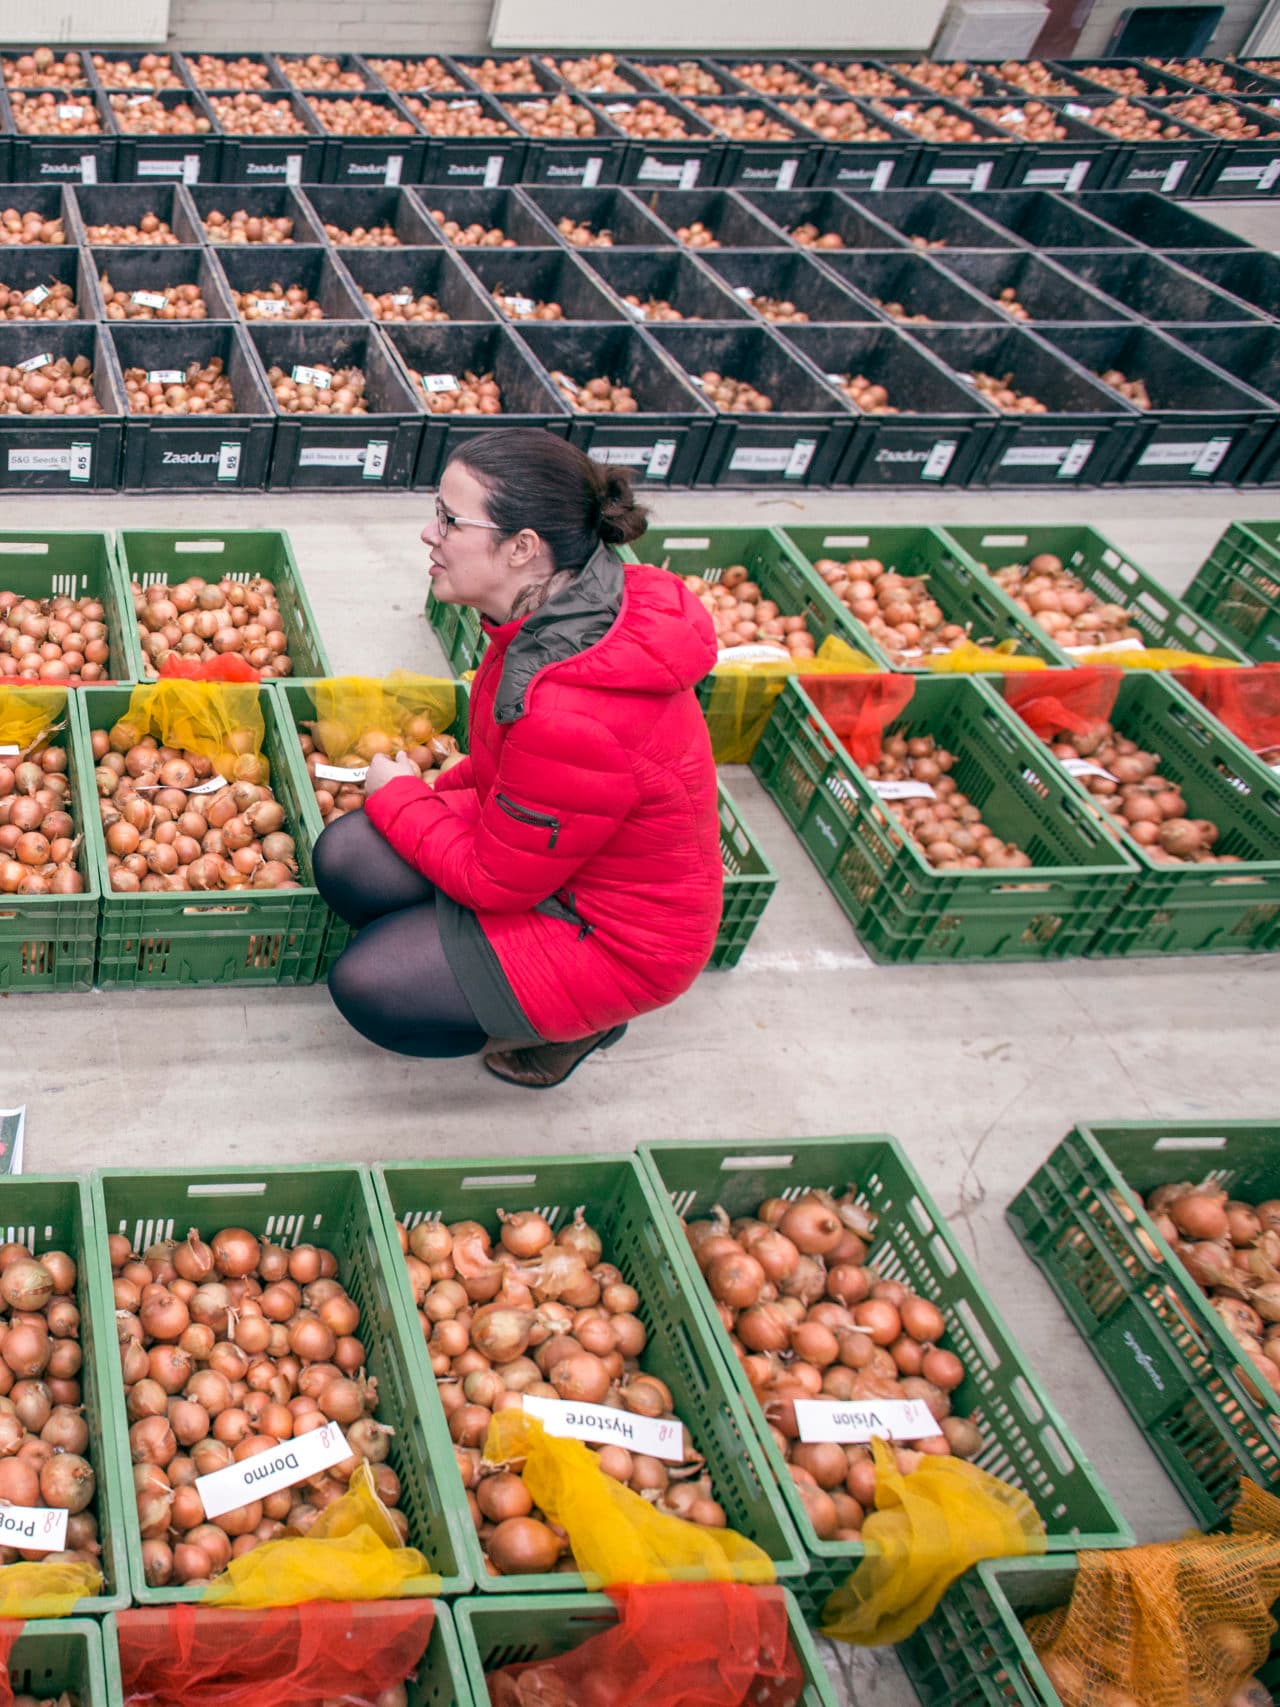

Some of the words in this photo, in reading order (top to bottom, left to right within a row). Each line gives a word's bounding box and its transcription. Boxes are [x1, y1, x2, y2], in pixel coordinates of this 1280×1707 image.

[10, 456, 30, 465] S&G
[32, 456, 58, 464] Seeds
[78, 457, 86, 470] 65
[227, 456, 236, 469] 66
[373, 455, 381, 468] 67
[566, 1412, 634, 1440] Hystore
[832, 1412, 884, 1430] Vision
[244, 1453, 300, 1485] Dormo
